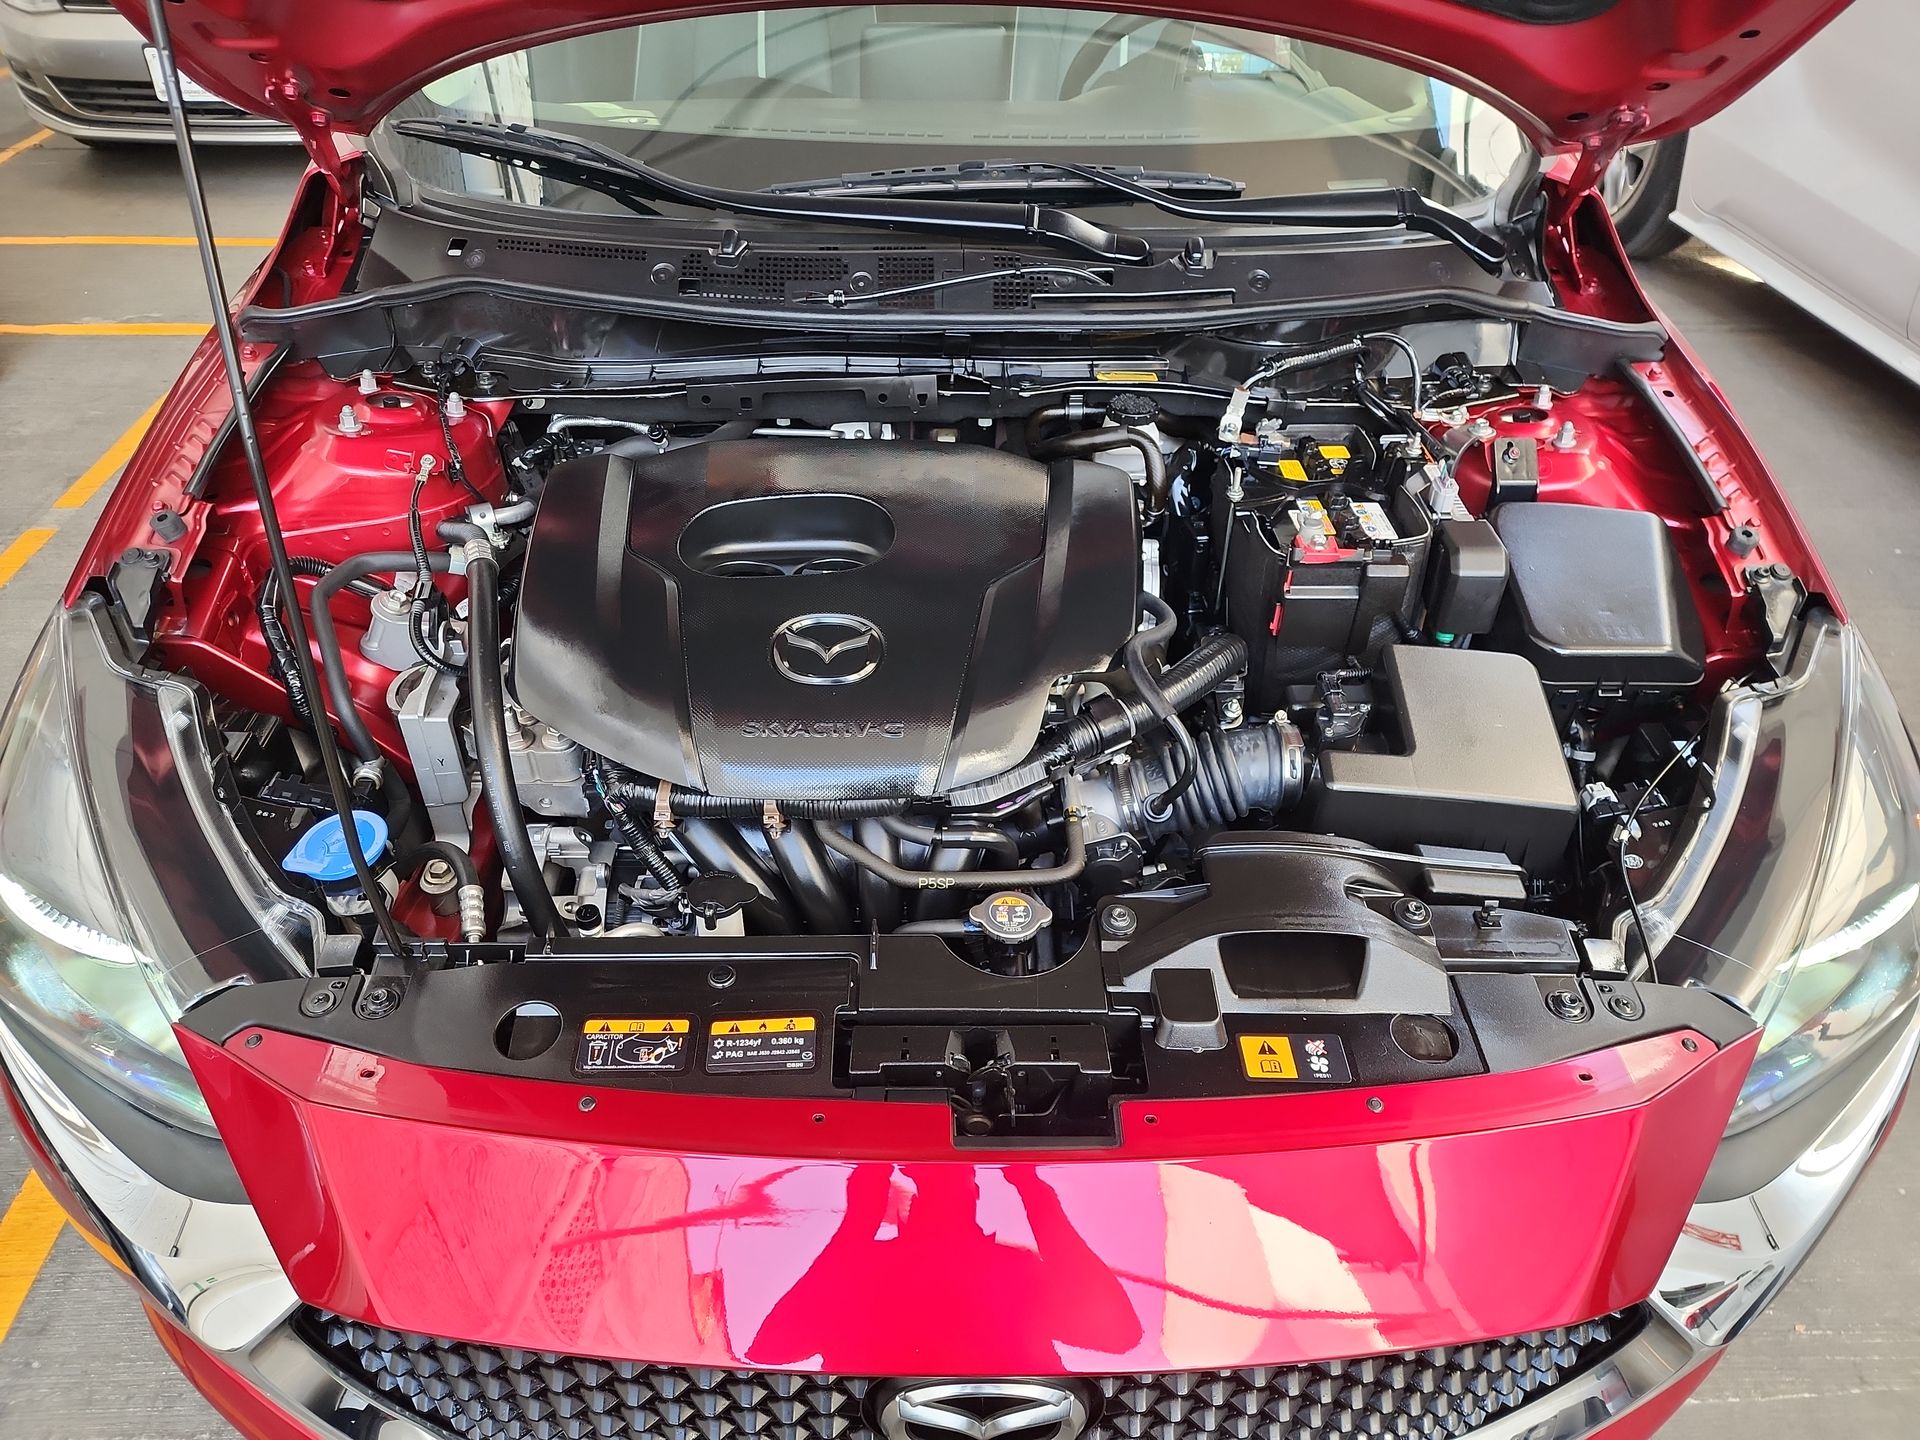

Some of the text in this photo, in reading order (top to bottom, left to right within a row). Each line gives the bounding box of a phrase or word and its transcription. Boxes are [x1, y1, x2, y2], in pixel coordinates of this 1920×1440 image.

[741, 721, 905, 739] SKYACTIV-G
[918, 877, 956, 889] P5SP
[726, 1039, 762, 1048] R-1234yf
[794, 1036, 805, 1046] kg
[725, 1050, 744, 1059] PAG
